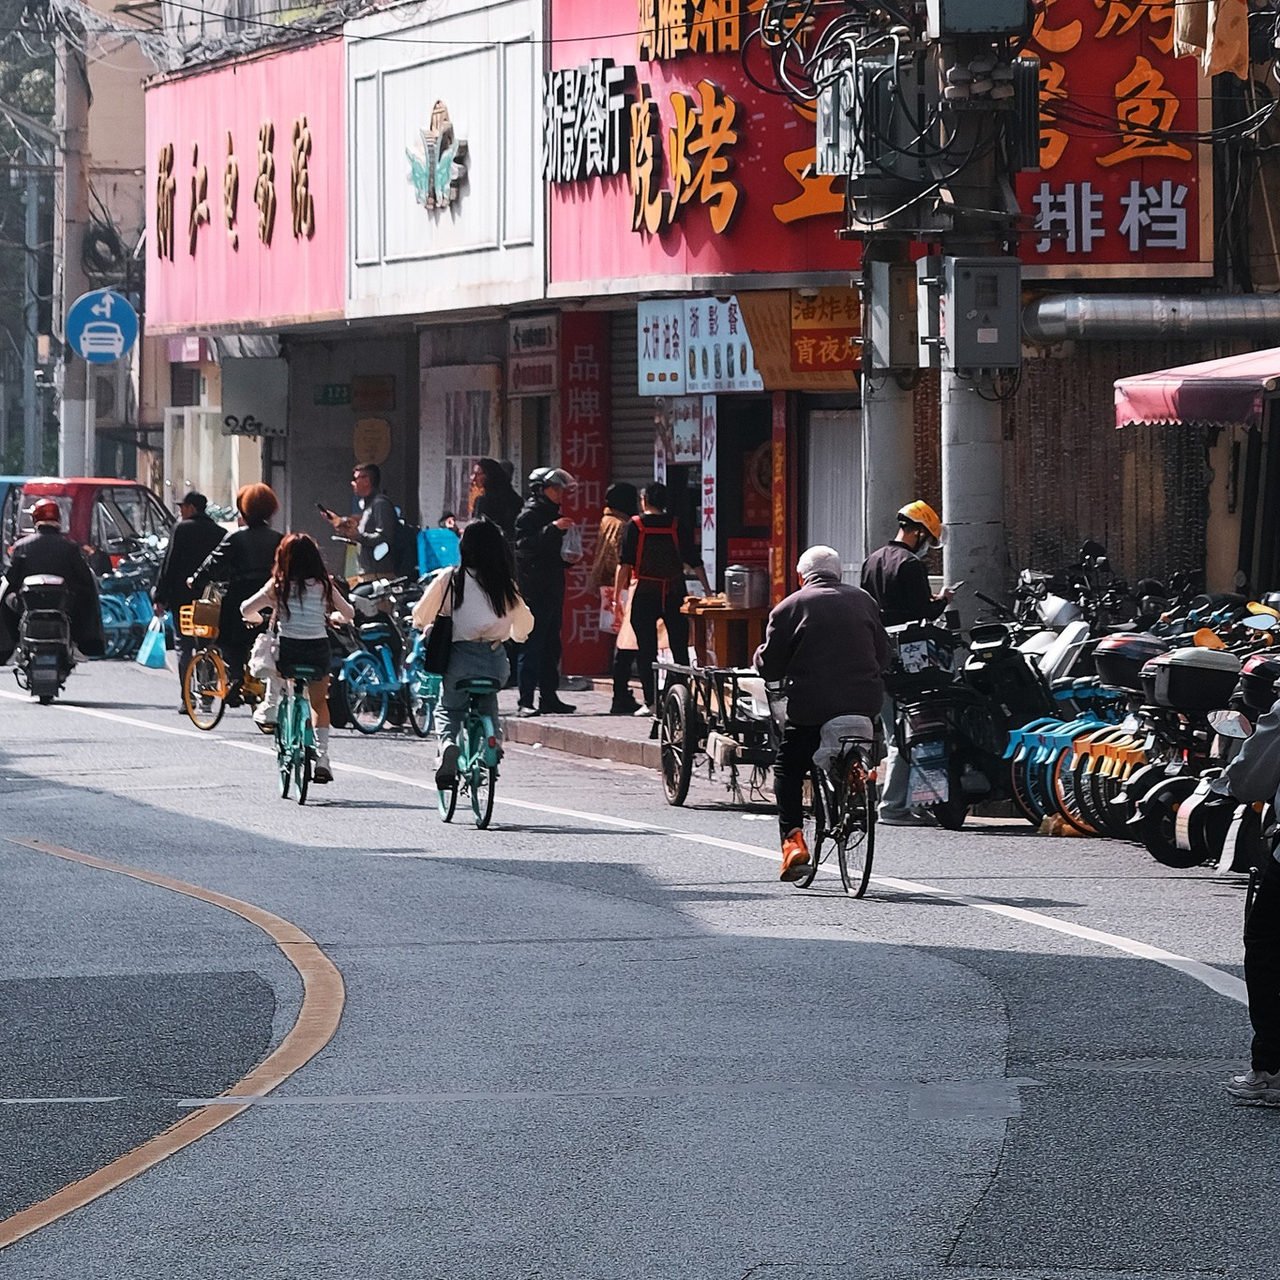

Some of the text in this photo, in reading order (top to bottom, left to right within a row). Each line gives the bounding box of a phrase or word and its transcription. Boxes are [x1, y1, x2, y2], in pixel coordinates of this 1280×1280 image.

[542, 59, 626, 182] 浙影餐厅
[1032, 180, 1189, 253] 排档
[567, 343, 604, 644] 品牌折扣专卖店
